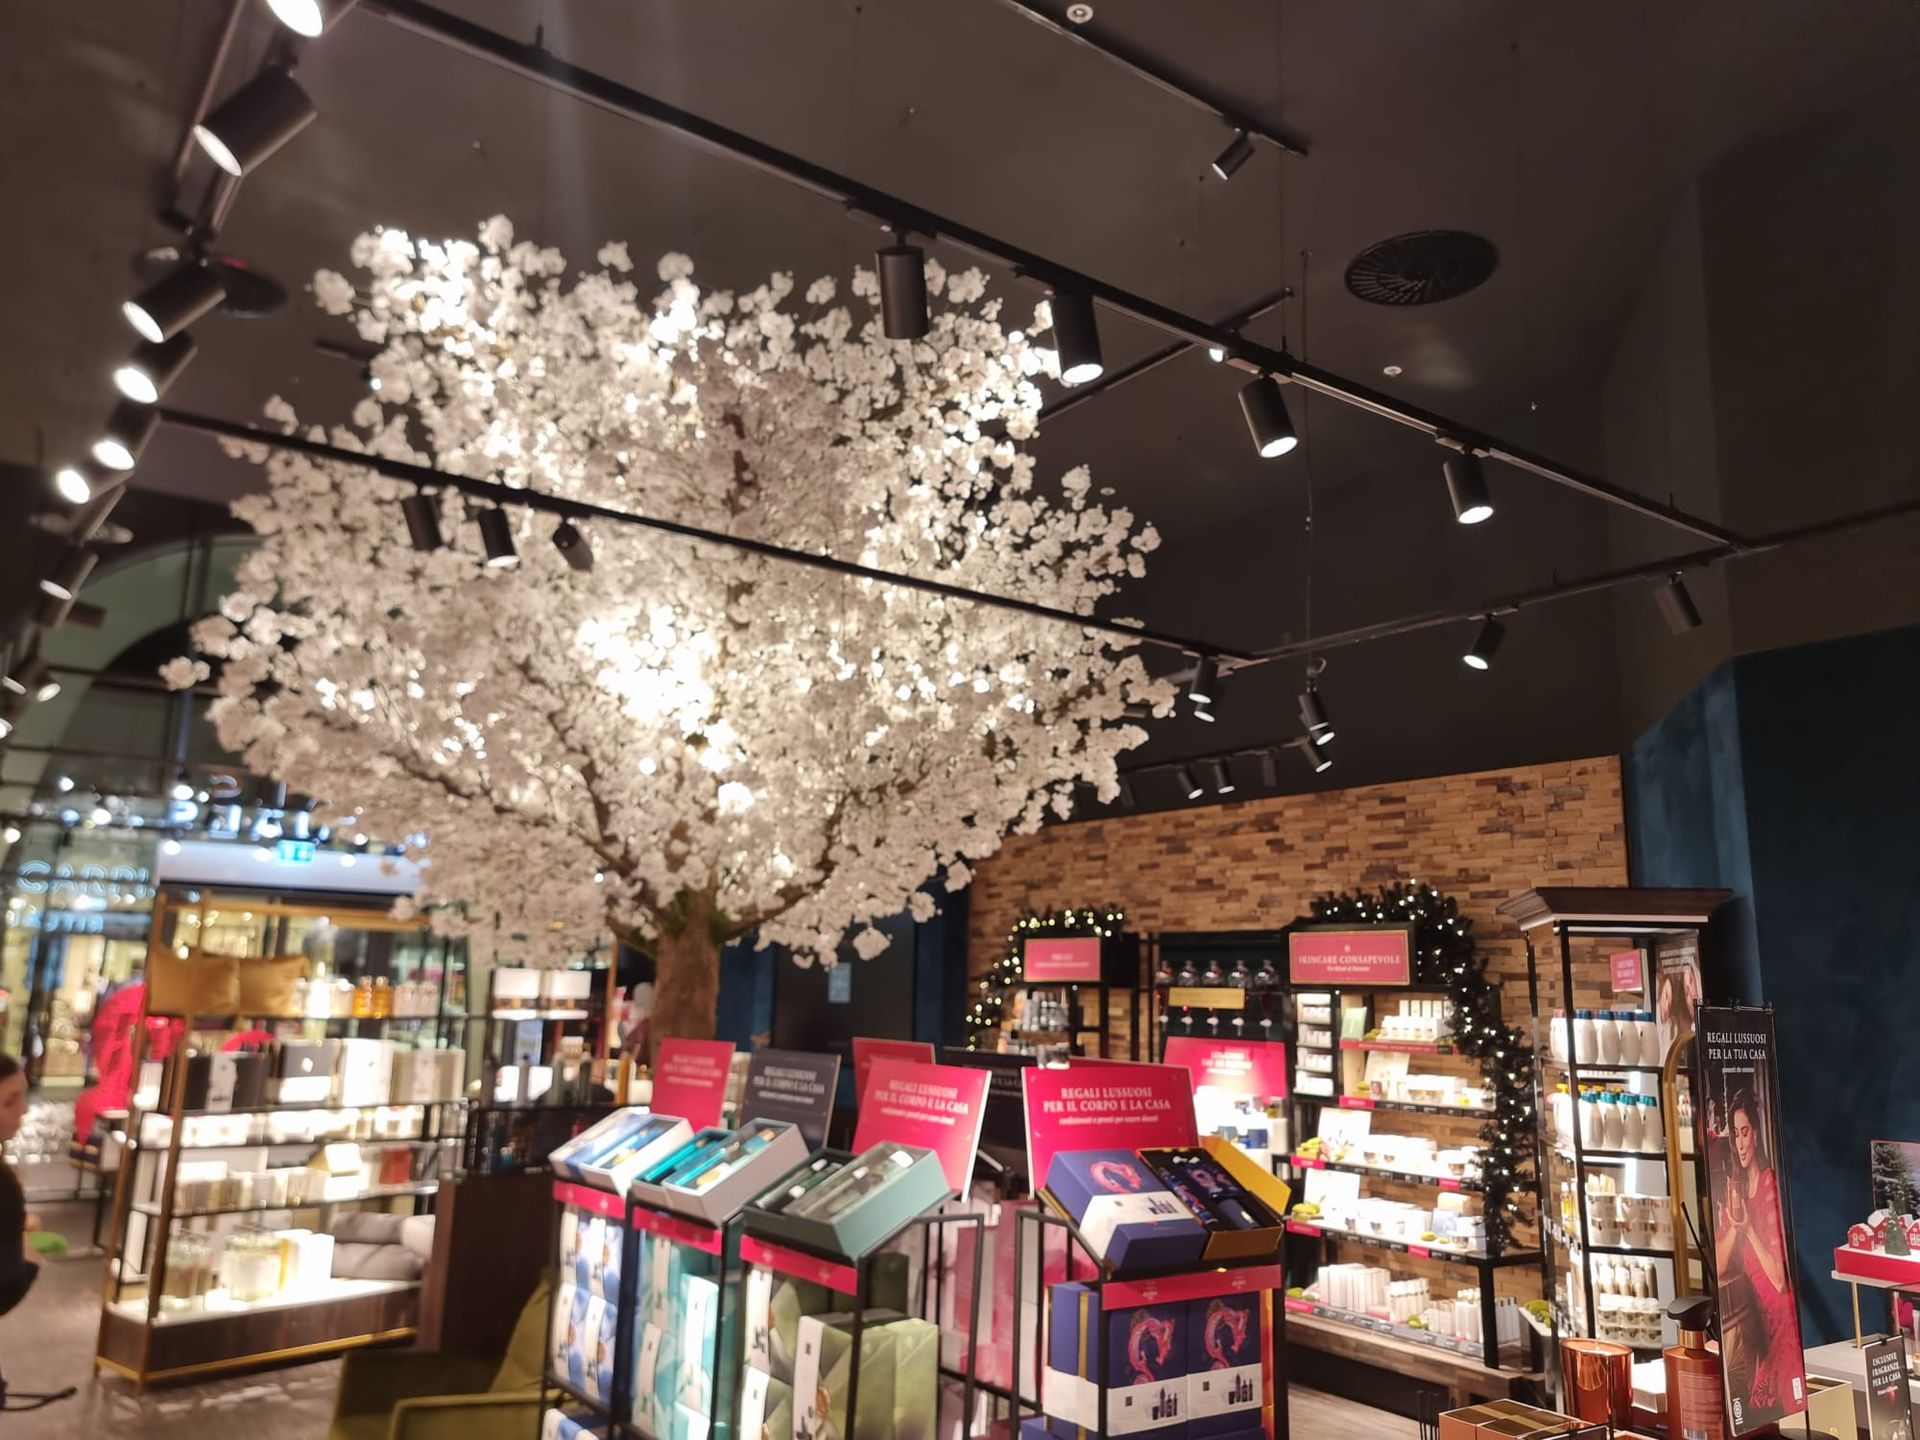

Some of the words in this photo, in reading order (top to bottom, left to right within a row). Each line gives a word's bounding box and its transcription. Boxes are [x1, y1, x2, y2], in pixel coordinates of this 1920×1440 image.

[1706, 1032, 1732, 1043] REGALI
[1734, 1032, 1767, 1044] LUSSUOSI
[1708, 1048, 1721, 1059] PER
[1723, 1048, 1732, 1059] LA
[1733, 1048, 1747, 1059] TUA
[1748, 1049, 1766, 1060] CASA
[1061, 1087, 1100, 1099] REGALI
[1102, 1087, 1152, 1098] LUSSUOSI
[1043, 1101, 1064, 1112] PER
[1067, 1101, 1077, 1112] IL
[1080, 1101, 1117, 1112] CORPO
[1120, 1101, 1127, 1111] E
[1130, 1100, 1142, 1110] LA
[1145, 1099, 1171, 1110] CASA
[1889, 1372, 1901, 1382] CASA
